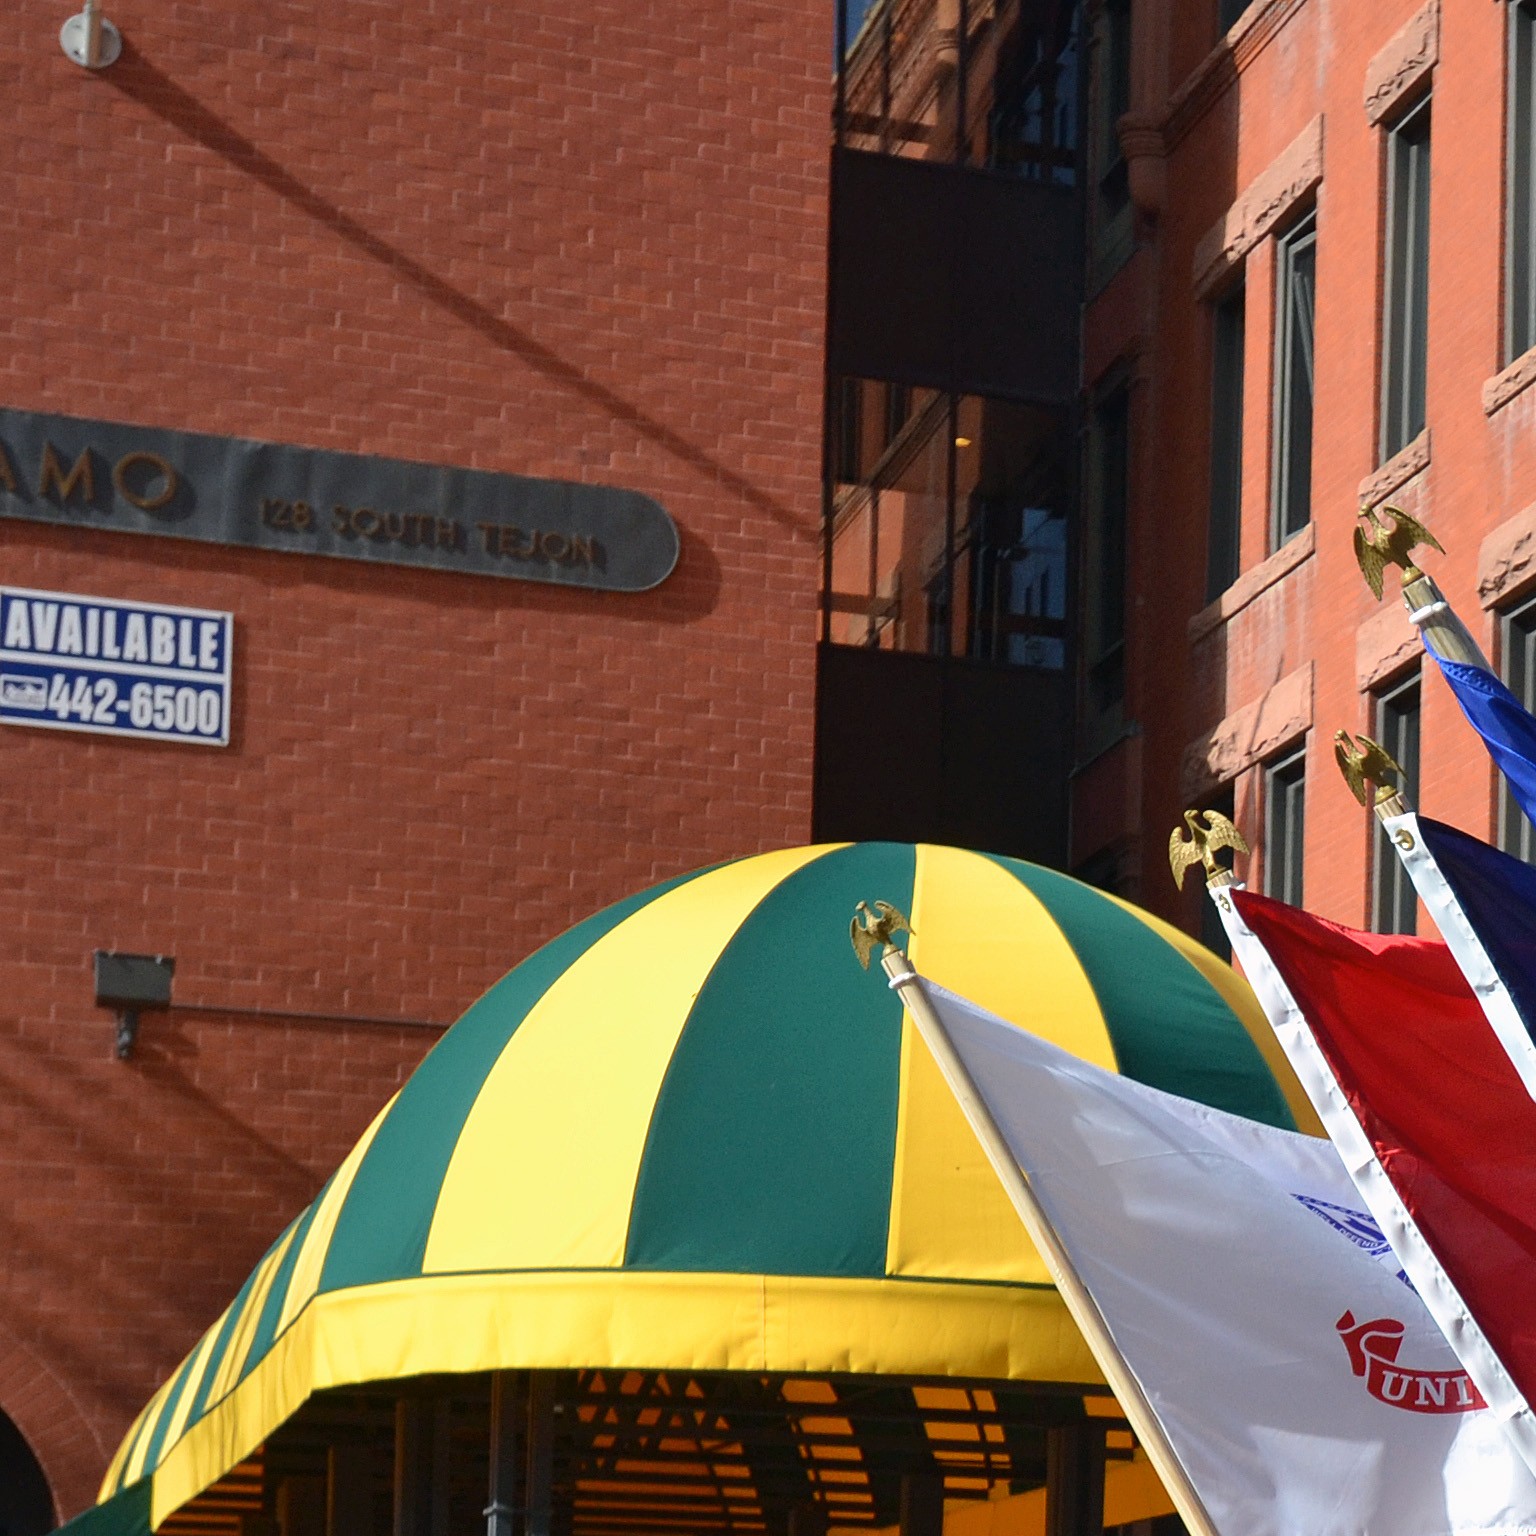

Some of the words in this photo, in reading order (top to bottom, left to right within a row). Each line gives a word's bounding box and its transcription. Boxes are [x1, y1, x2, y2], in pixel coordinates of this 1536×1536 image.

[259, 499, 312, 532] 128
[332, 504, 457, 549] SOUTH
[476, 521, 597, 566] TEJON
[4, 599, 219, 670] AVAILABLE
[48, 673, 220, 735] 442-6500
